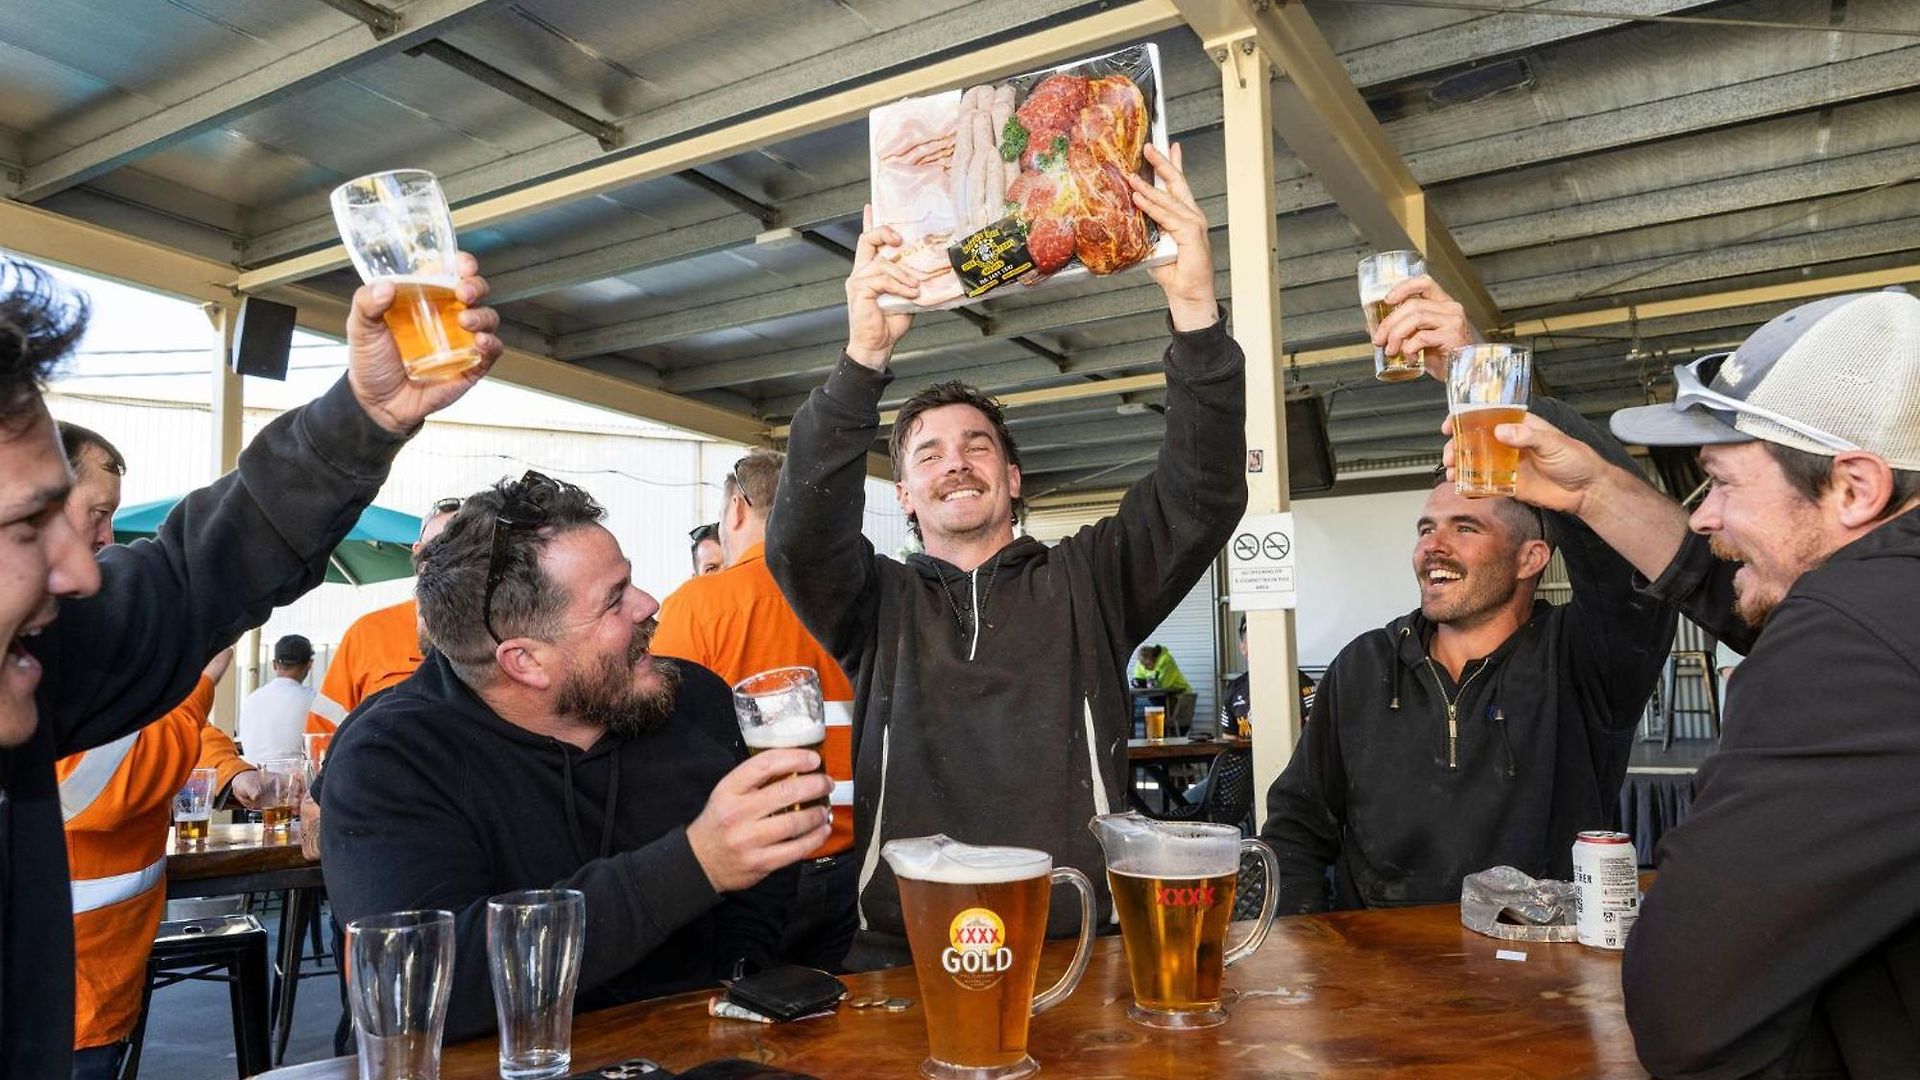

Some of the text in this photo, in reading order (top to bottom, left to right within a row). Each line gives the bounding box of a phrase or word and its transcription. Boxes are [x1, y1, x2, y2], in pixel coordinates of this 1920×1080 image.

[1160, 887, 1216, 906] XXXX
[954, 927, 1001, 944] XXXX
[942, 946, 1013, 973] GOLD
